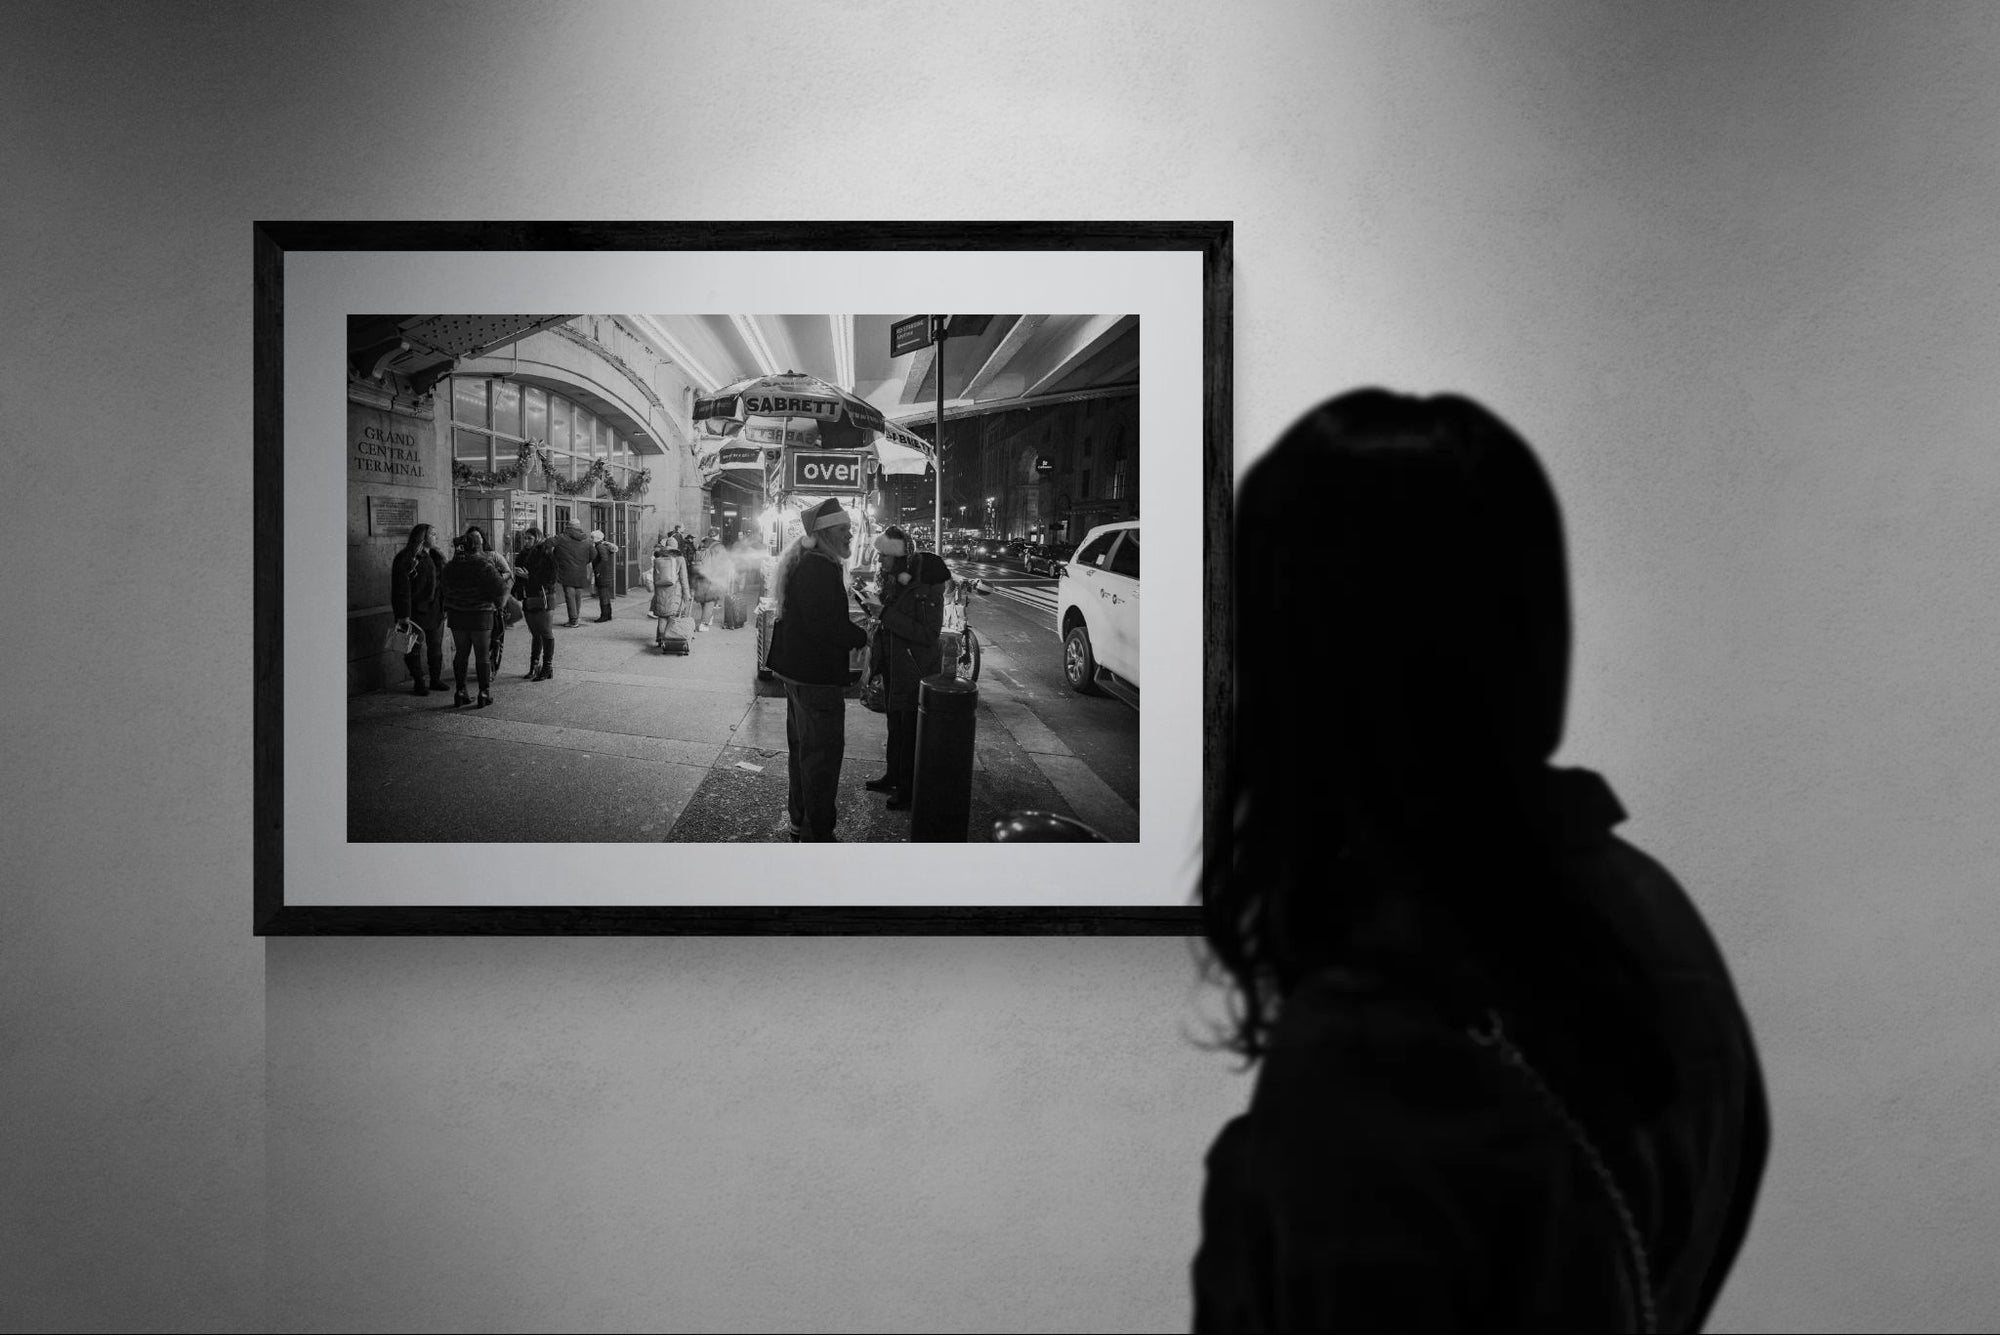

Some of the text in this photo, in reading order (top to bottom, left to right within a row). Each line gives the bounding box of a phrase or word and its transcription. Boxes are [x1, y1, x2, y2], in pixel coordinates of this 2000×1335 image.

[746, 397, 840, 415] SABRETT
[364, 426, 415, 446] GRAND
[358, 442, 420, 462] CENTRAL
[354, 457, 425, 477] TERMINAL
